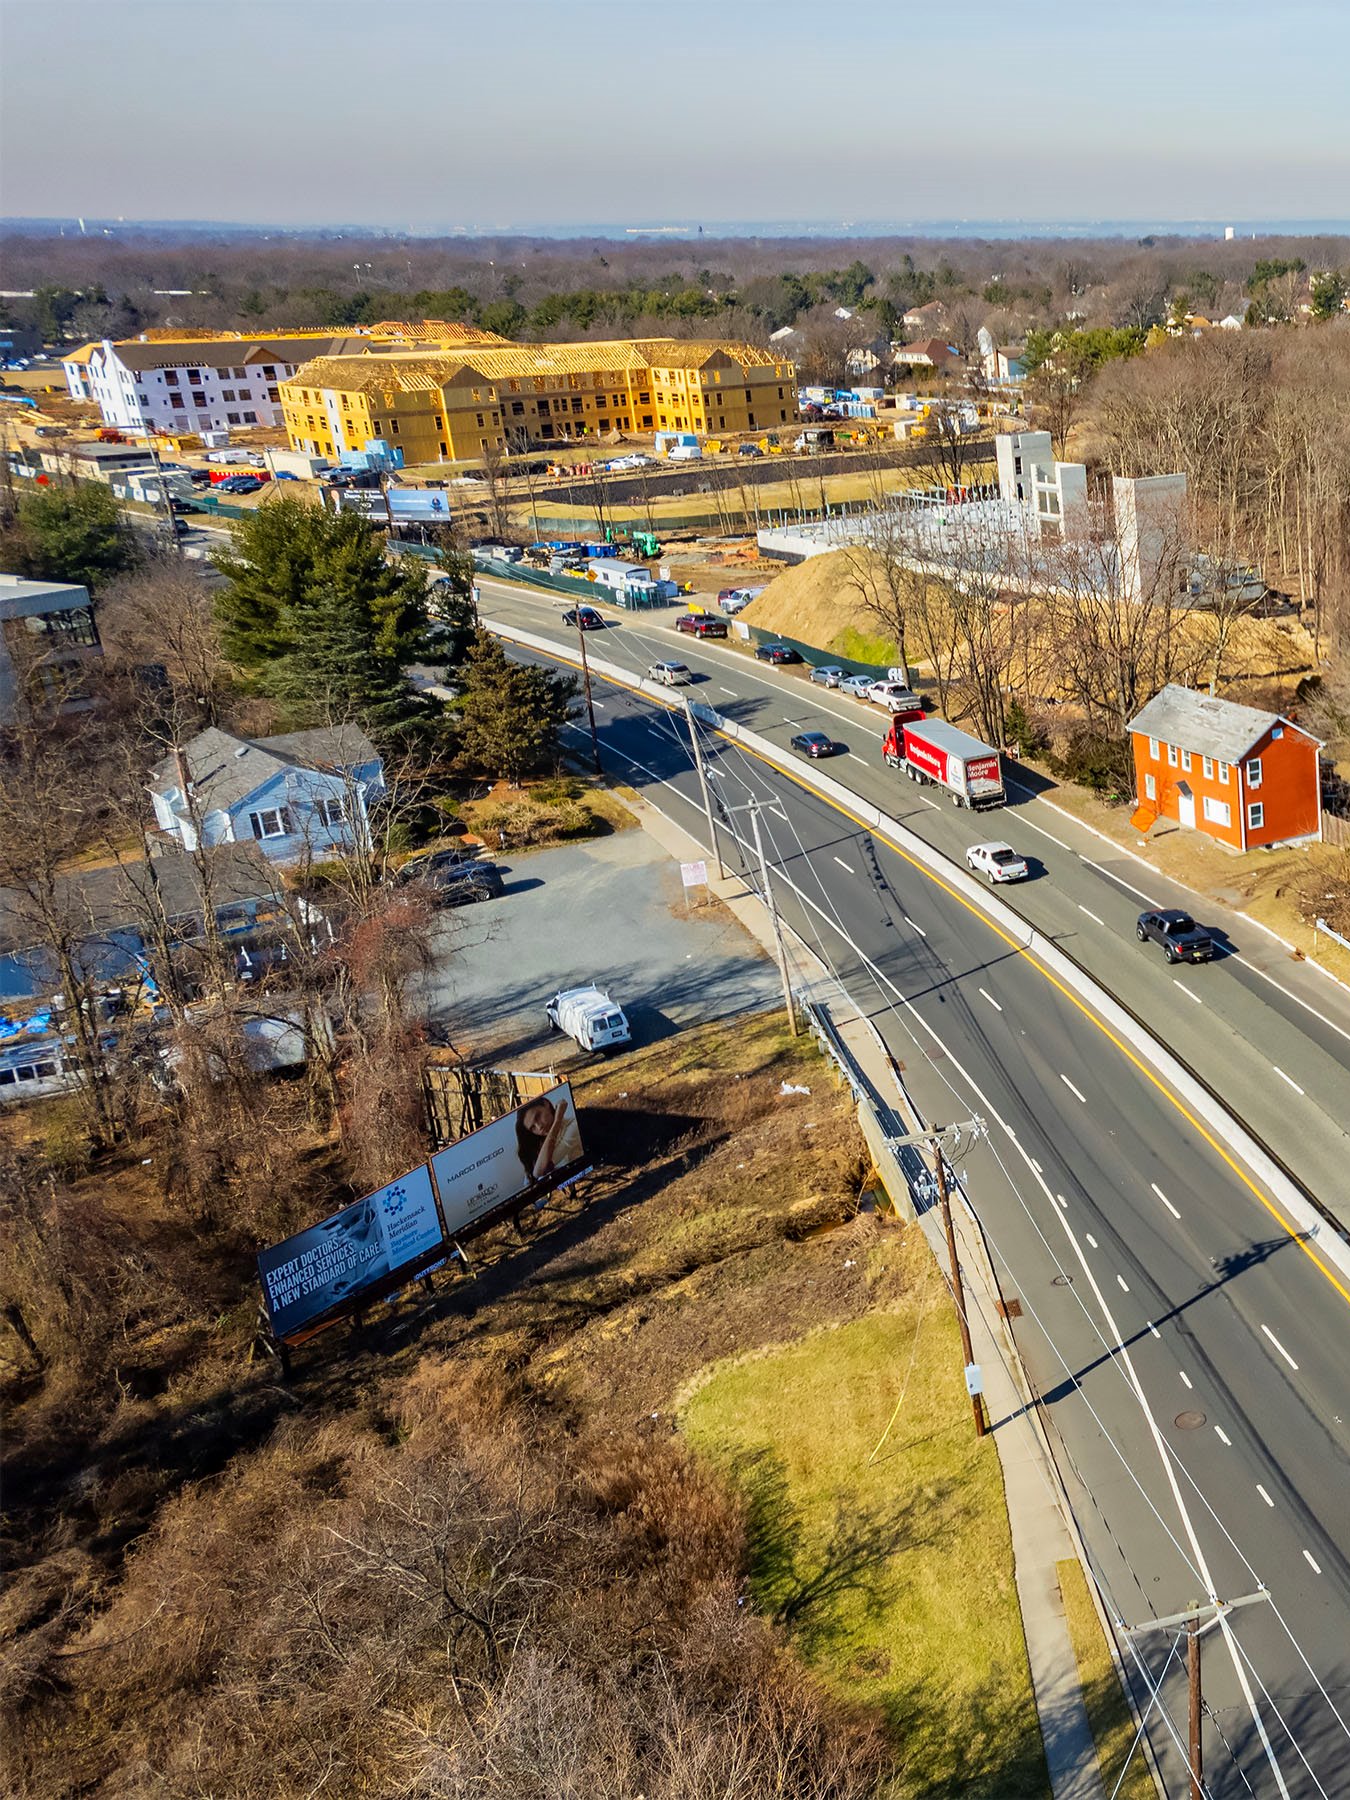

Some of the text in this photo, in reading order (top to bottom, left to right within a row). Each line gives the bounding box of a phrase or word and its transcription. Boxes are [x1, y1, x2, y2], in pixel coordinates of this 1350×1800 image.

[967, 760, 997, 772] Benjamin
[967, 769, 989, 779] Moore
[447, 1147, 505, 1184] MARCO BICEGO
[387, 1205, 426, 1232] Hackensack
[388, 1219, 418, 1240] Meridian
[266, 1238, 341, 1286] EXPERT DOCTORS.
[268, 1264, 315, 1299] ENHANCED
[315, 1242, 357, 1274] SERVICES.
[273, 1298, 280, 1313] A
[280, 1287, 301, 1308] NEW
[302, 1261, 346, 1295] STANDARD
[347, 1253, 358, 1270] OF
